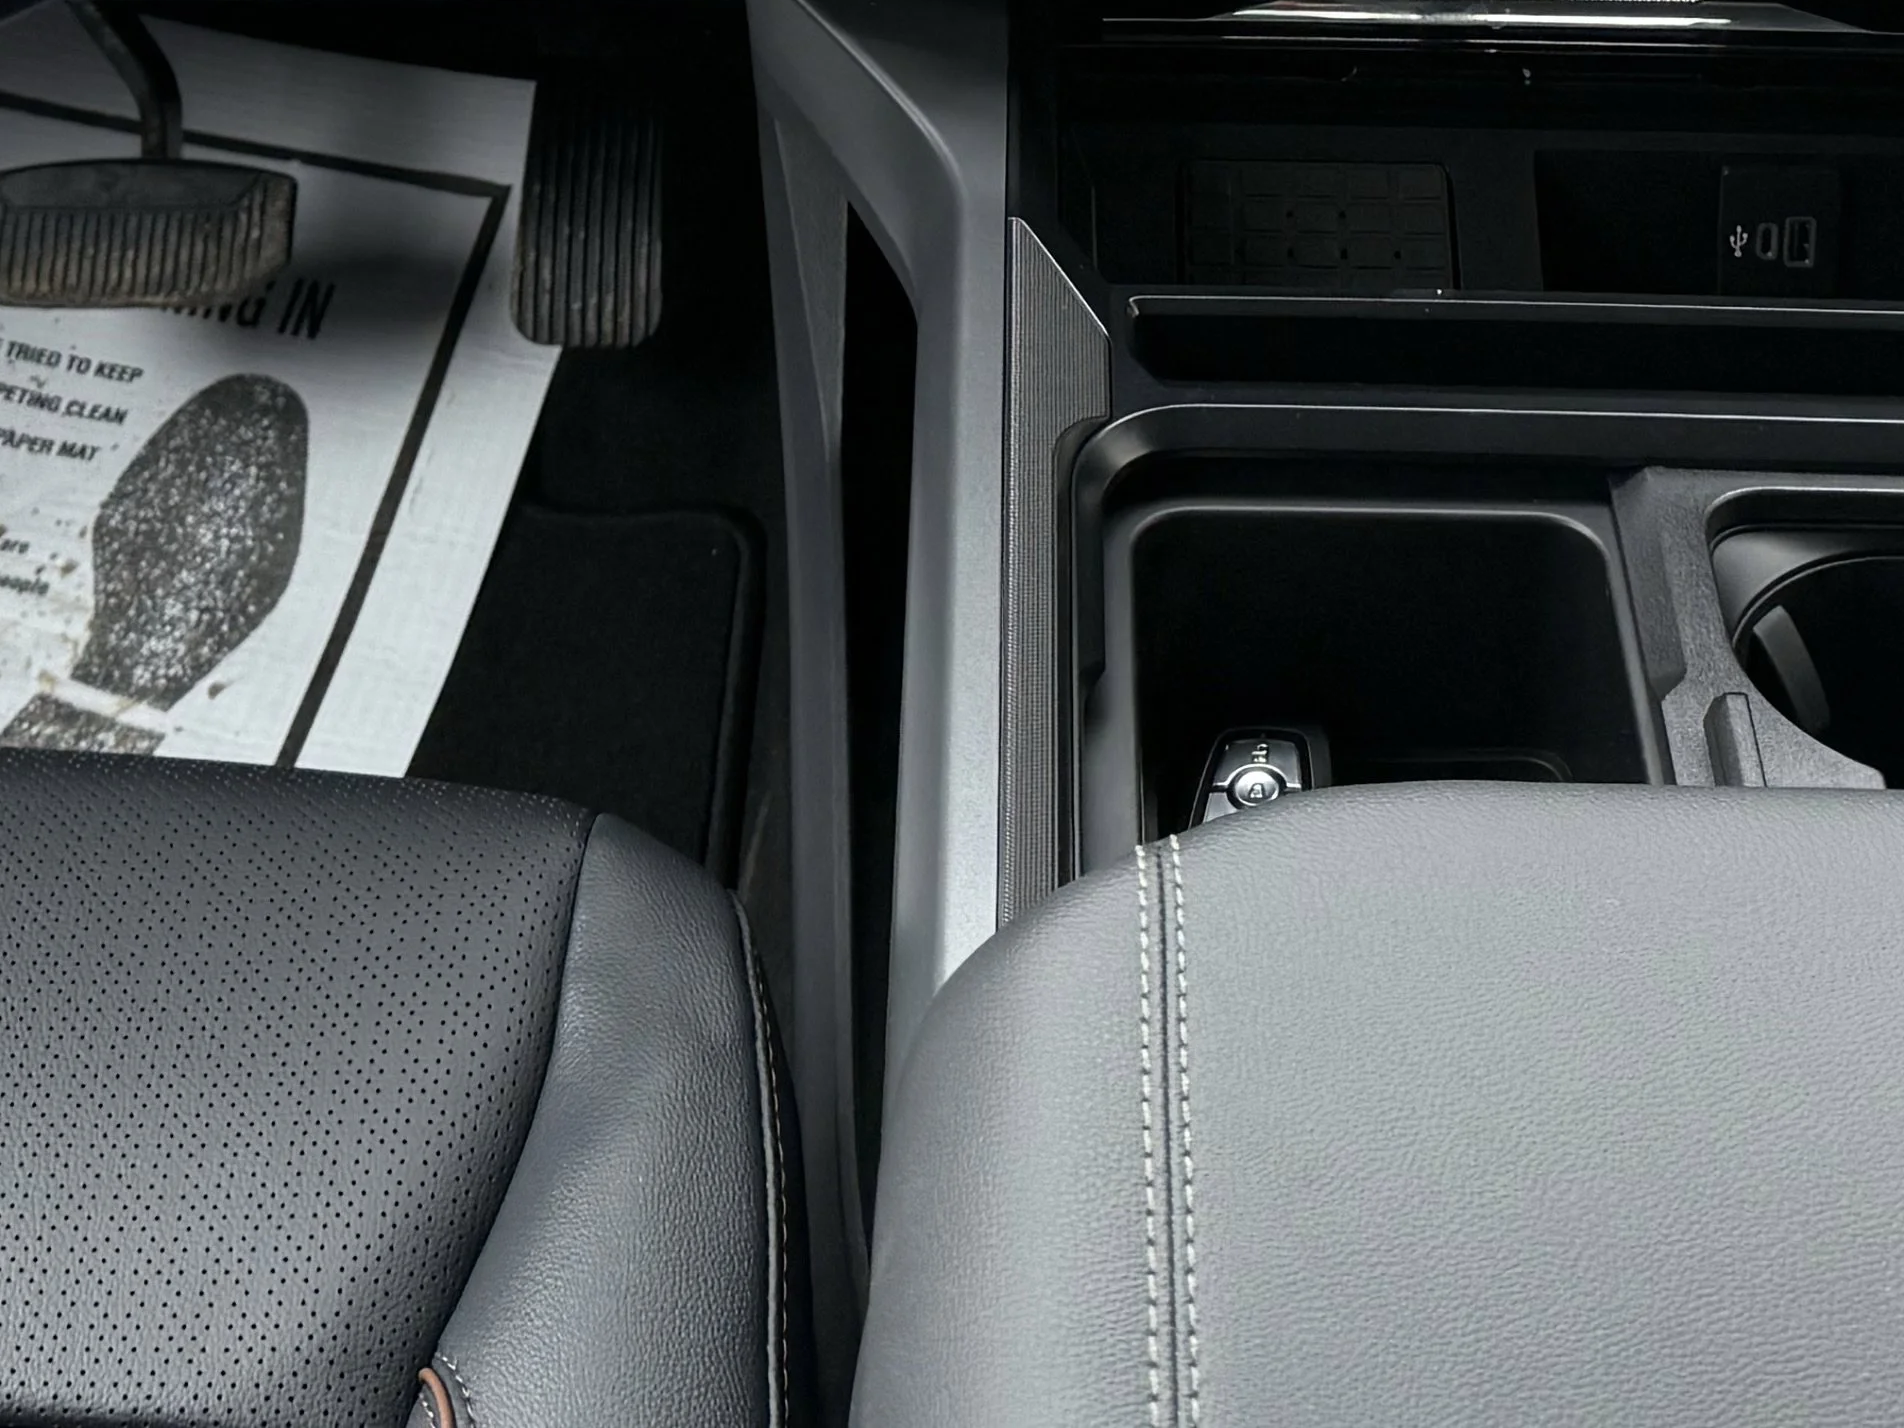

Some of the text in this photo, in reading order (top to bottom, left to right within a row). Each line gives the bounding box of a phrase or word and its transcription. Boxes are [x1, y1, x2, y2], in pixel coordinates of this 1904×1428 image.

[277, 277, 336, 340] IN
[6, 340, 62, 369] TRIED
[66, 354, 92, 376] TO
[94, 360, 144, 384] KEEP
[65, 399, 129, 425] CLEAN
[56, 440, 100, 461] MAT
